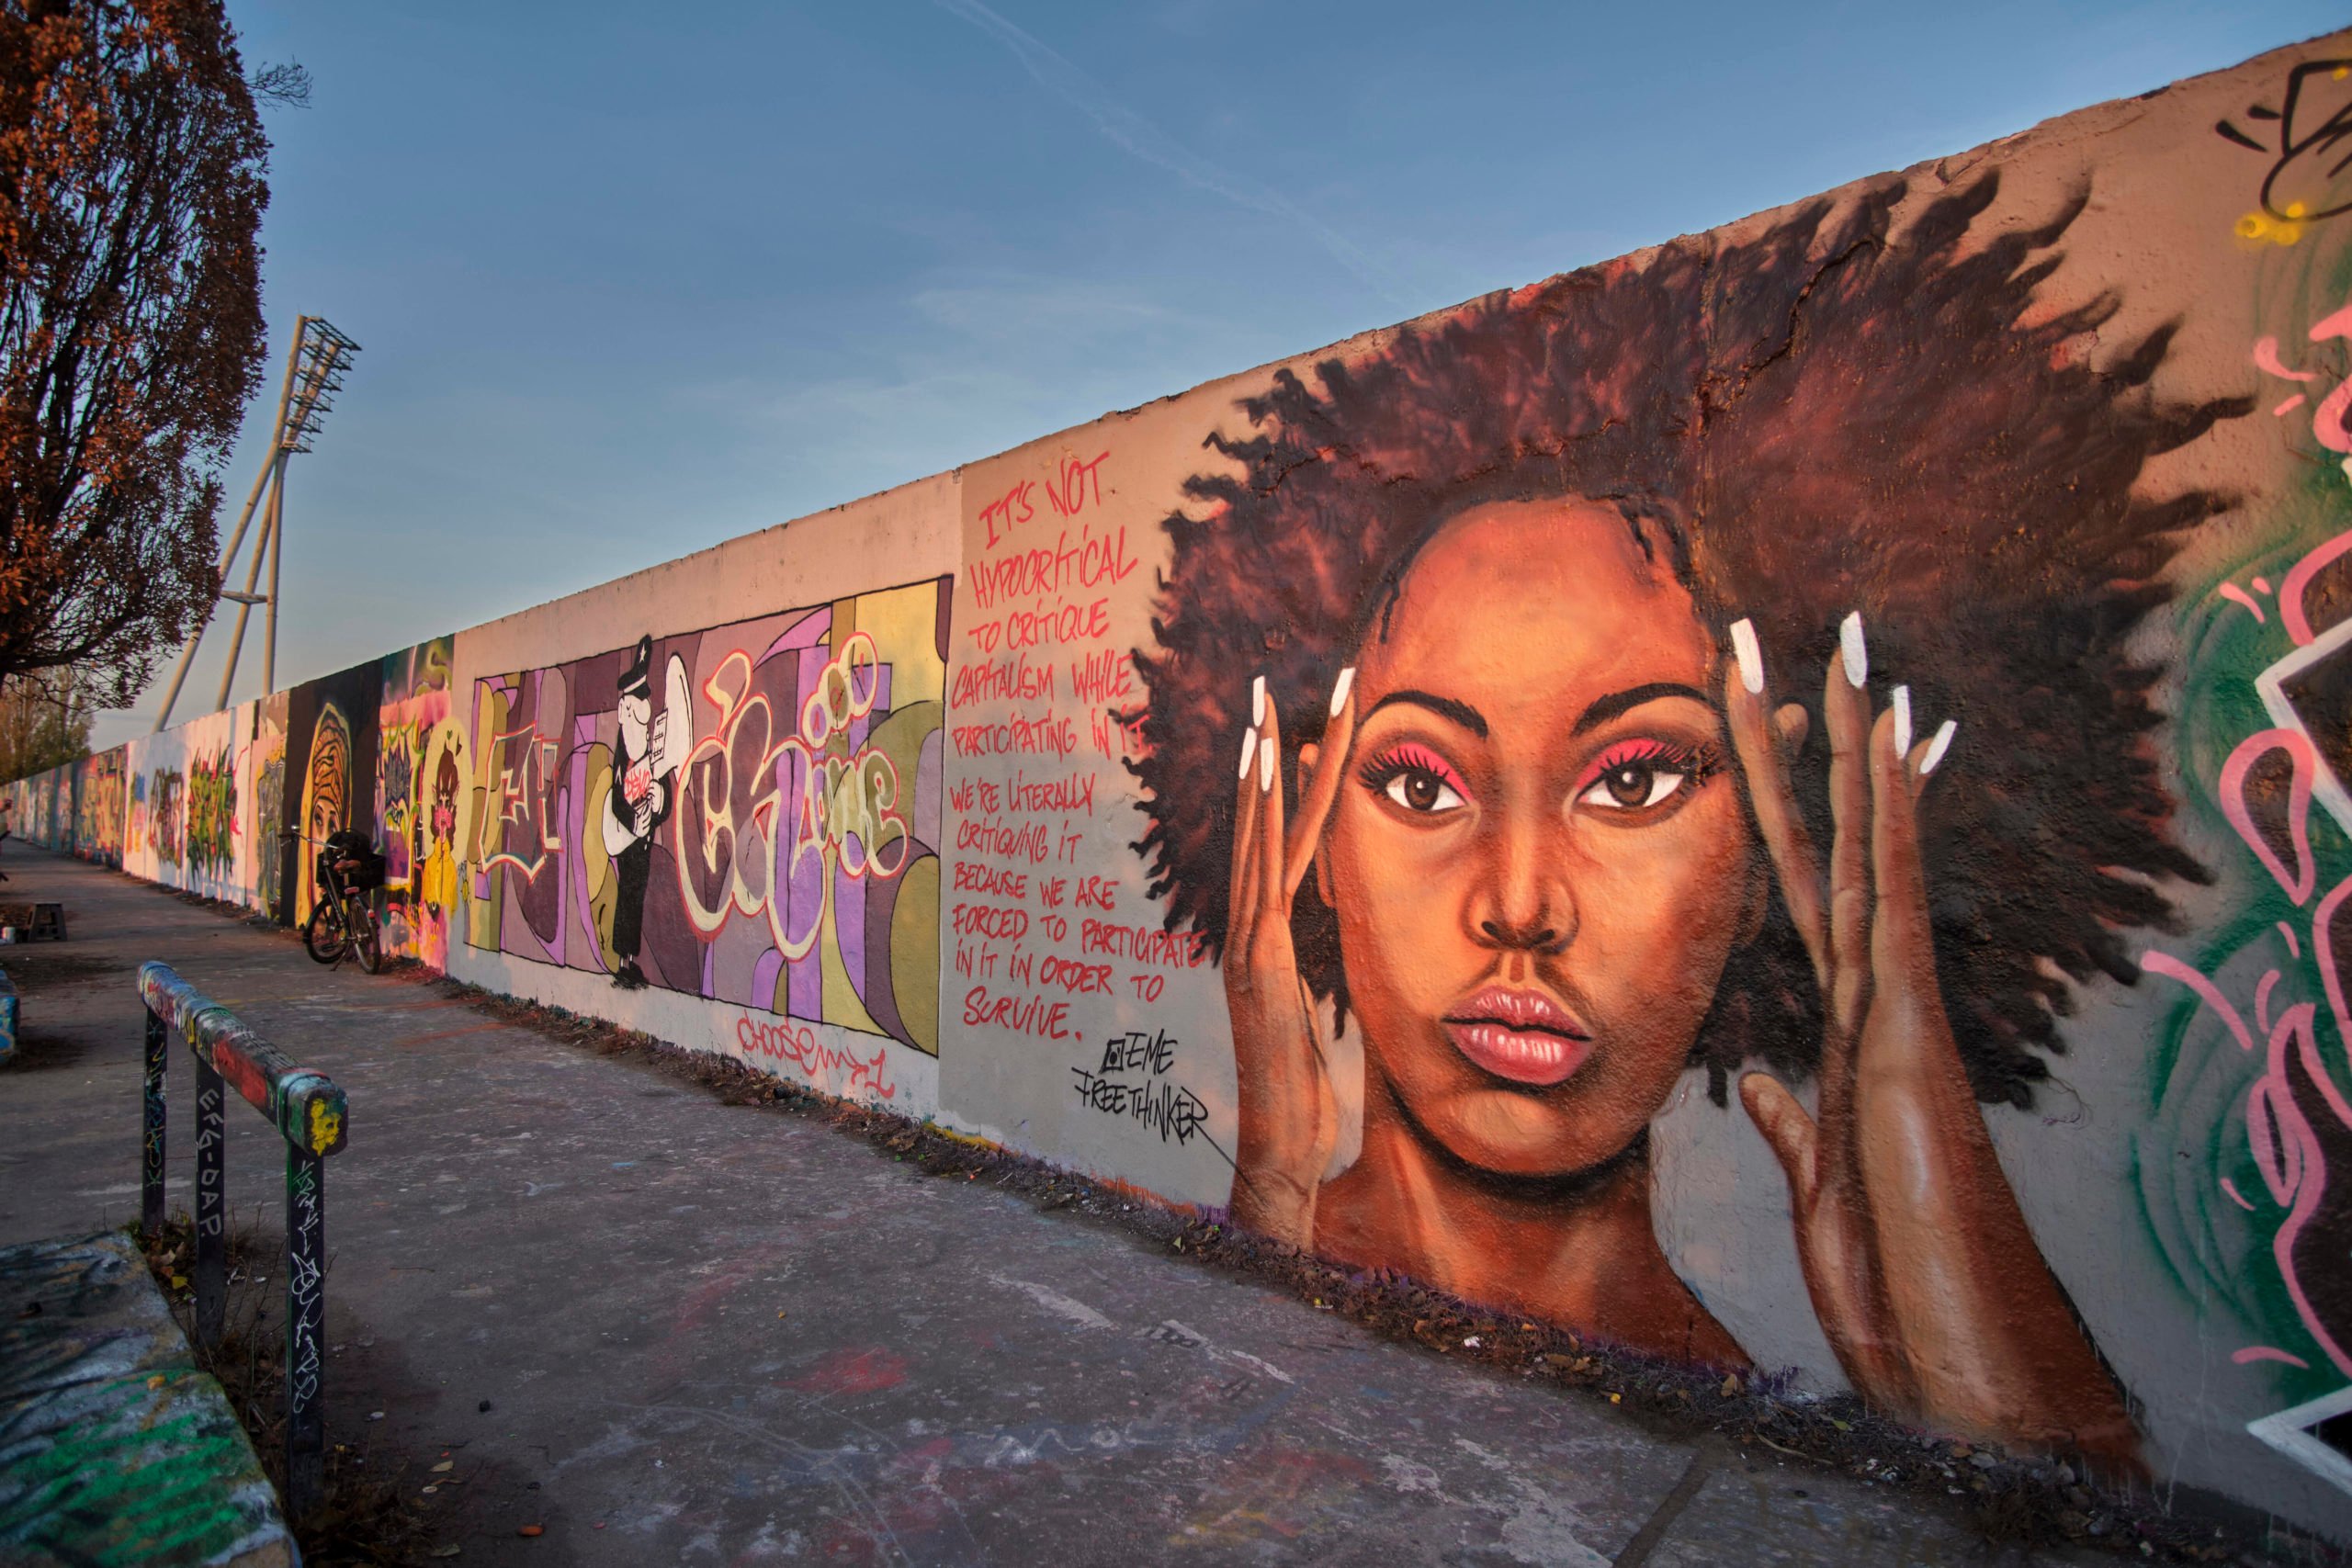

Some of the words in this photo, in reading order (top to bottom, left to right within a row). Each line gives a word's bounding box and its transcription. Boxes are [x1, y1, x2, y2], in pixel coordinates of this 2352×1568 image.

[978, 480, 1035, 549] IT'S
[1046, 451, 1110, 516] NOT
[970, 524, 1138, 608] HYPOCRITICAL
[967, 619, 1001, 653] TO
[1007, 595, 1109, 650] CRITIQUE
[952, 652, 1054, 709] CAPITALISM
[1071, 649, 1133, 704] WHILE
[952, 708, 1077, 762] PARTICIPATING
[1091, 707, 1112, 761] IN
[950, 780, 1000, 815] WE'RE
[1010, 771, 1095, 818] LITERALLY
[957, 817, 1048, 865] CRITIQUING
[1057, 819, 1083, 865] IT
[955, 862, 1027, 898] BECAUSE
[1039, 874, 1068, 909] WE
[1074, 874, 1121, 911] ARE
[953, 903, 1028, 940] FORCED
[1039, 914, 1068, 942] TO
[1081, 919, 1206, 967] PARTICIPATE
[956, 937, 974, 982] IN
[979, 939, 1000, 979] IT
[1011, 942, 1034, 990] IN
[1040, 955, 1114, 995] ORDER
[1130, 975, 1165, 1003] TO
